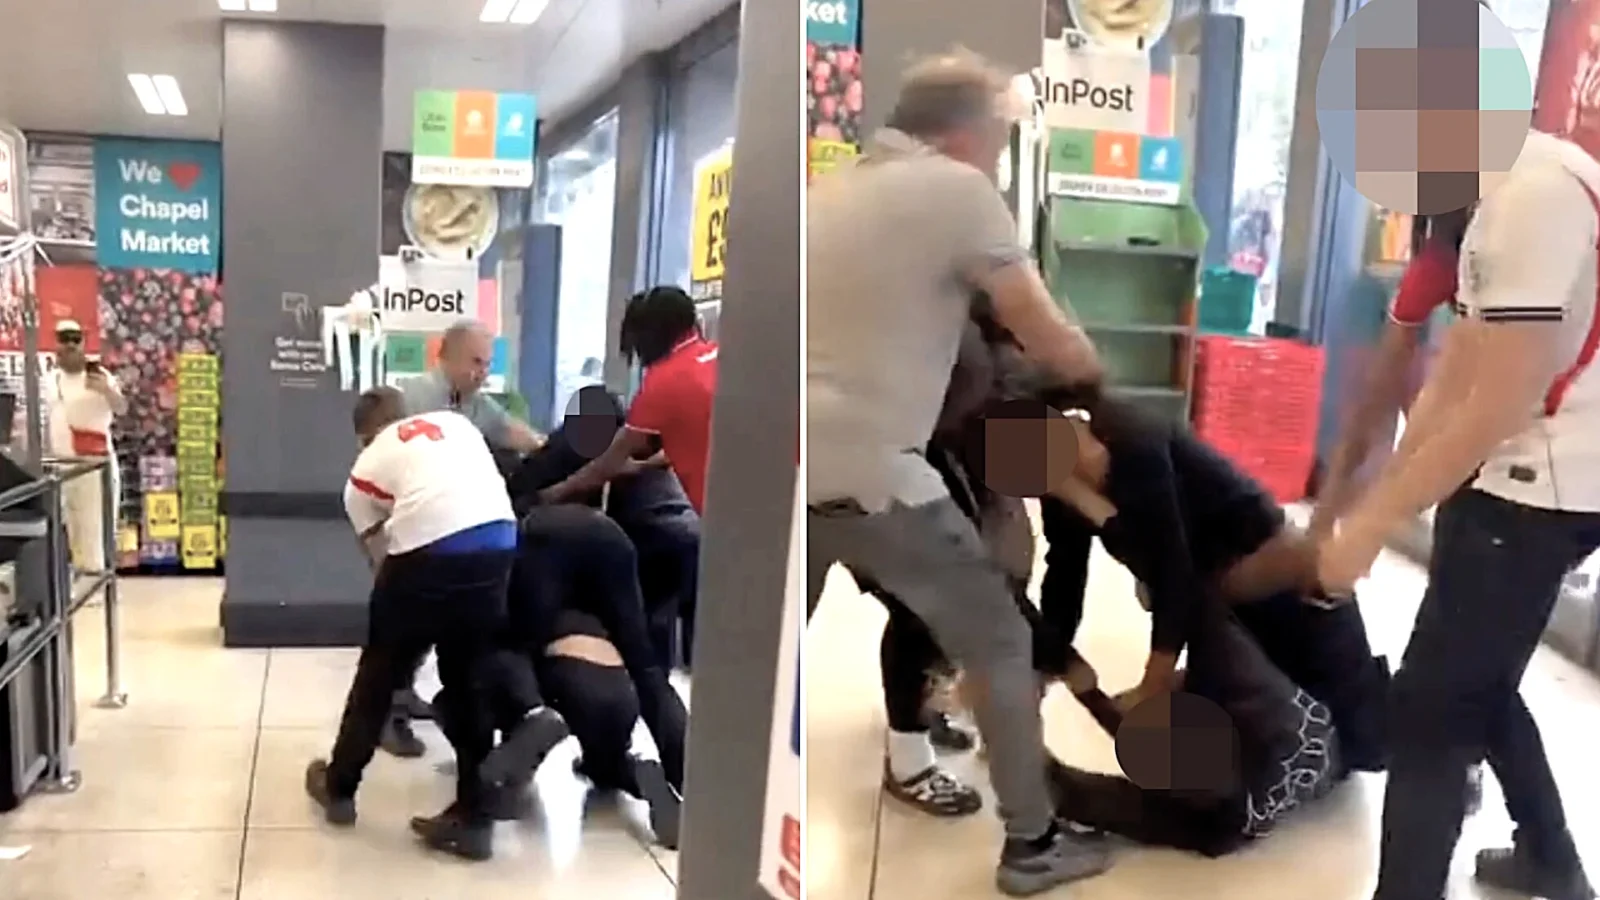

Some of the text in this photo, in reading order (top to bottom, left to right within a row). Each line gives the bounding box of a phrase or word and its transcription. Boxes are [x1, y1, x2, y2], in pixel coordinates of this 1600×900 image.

[1045, 76, 1134, 112] InPost
[117, 158, 162, 184] We
[120, 193, 209, 225] Chapel
[121, 227, 211, 255] Market
[383, 286, 465, 315] InPost
[397, 418, 445, 444] 4
